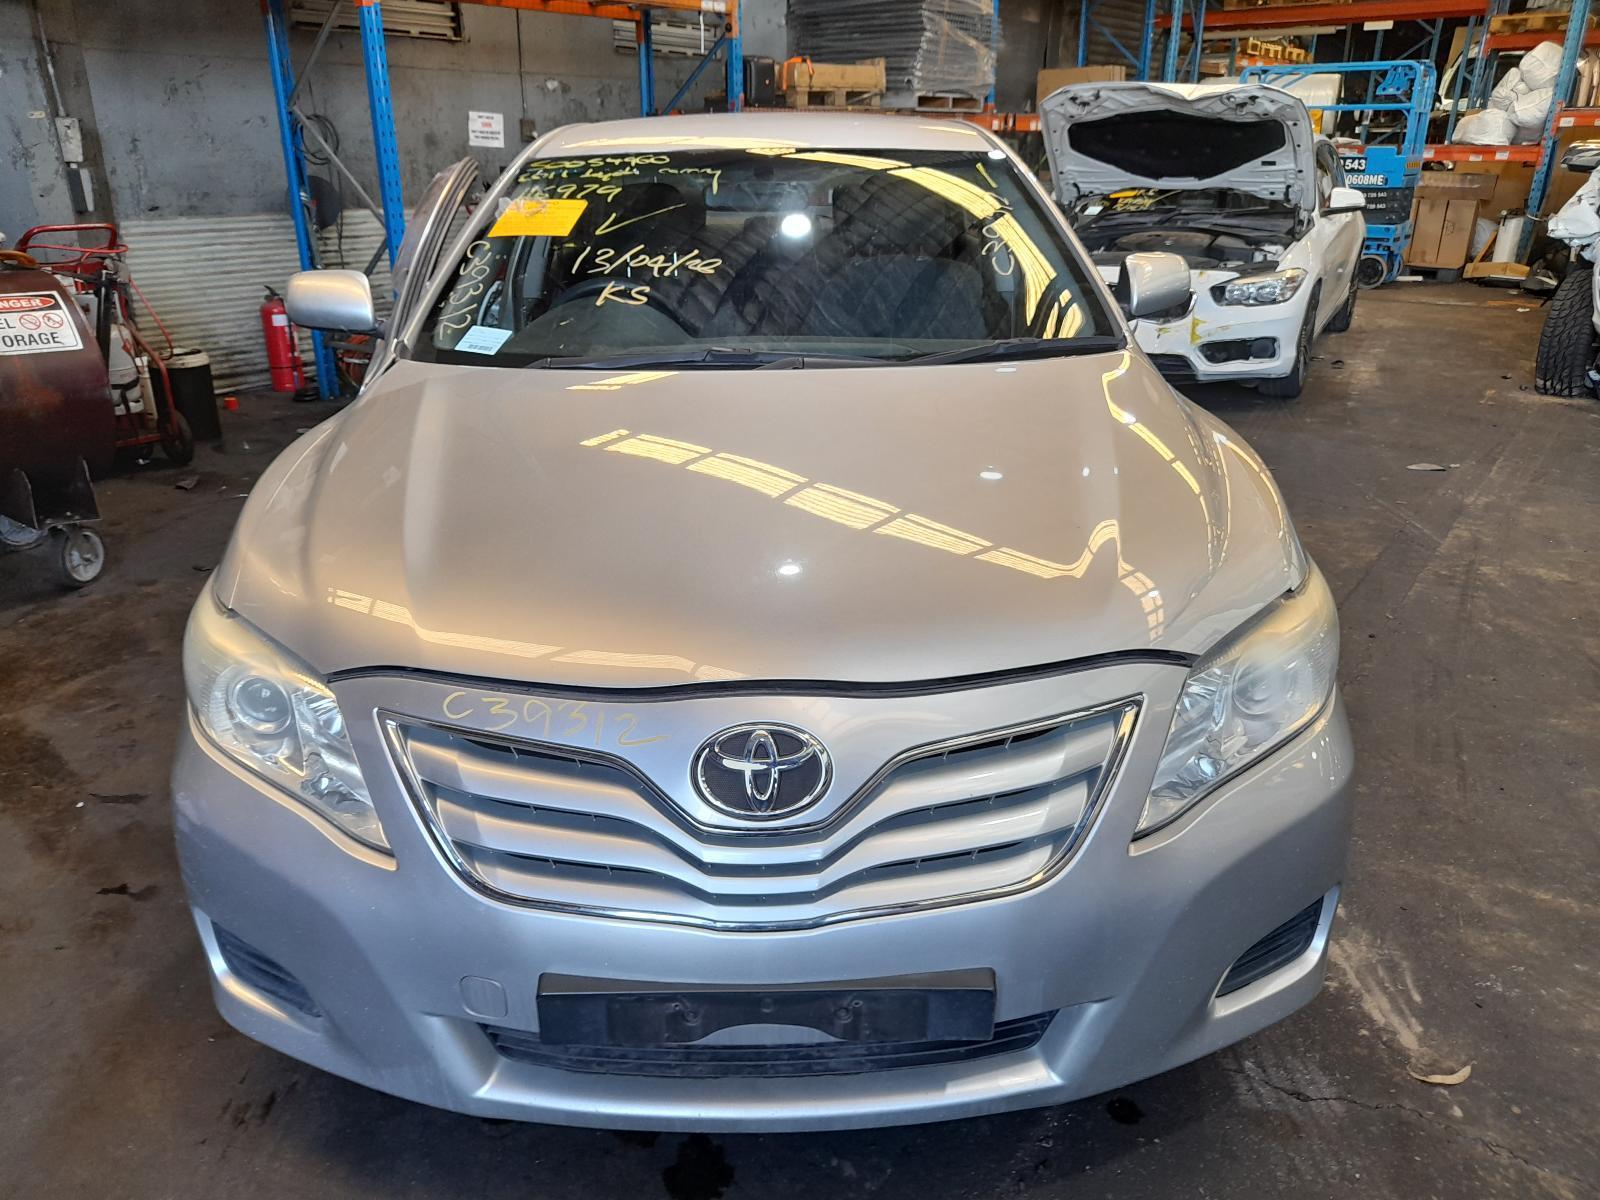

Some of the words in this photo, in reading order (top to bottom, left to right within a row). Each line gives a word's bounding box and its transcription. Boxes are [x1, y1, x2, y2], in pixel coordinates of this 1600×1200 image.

[1344, 158, 1366, 170] 543
[595, 280, 651, 306] KS
[0, 298, 43, 309] NGER
[0, 318, 16, 330] EL
[1, 331, 61, 348] ORAGE
